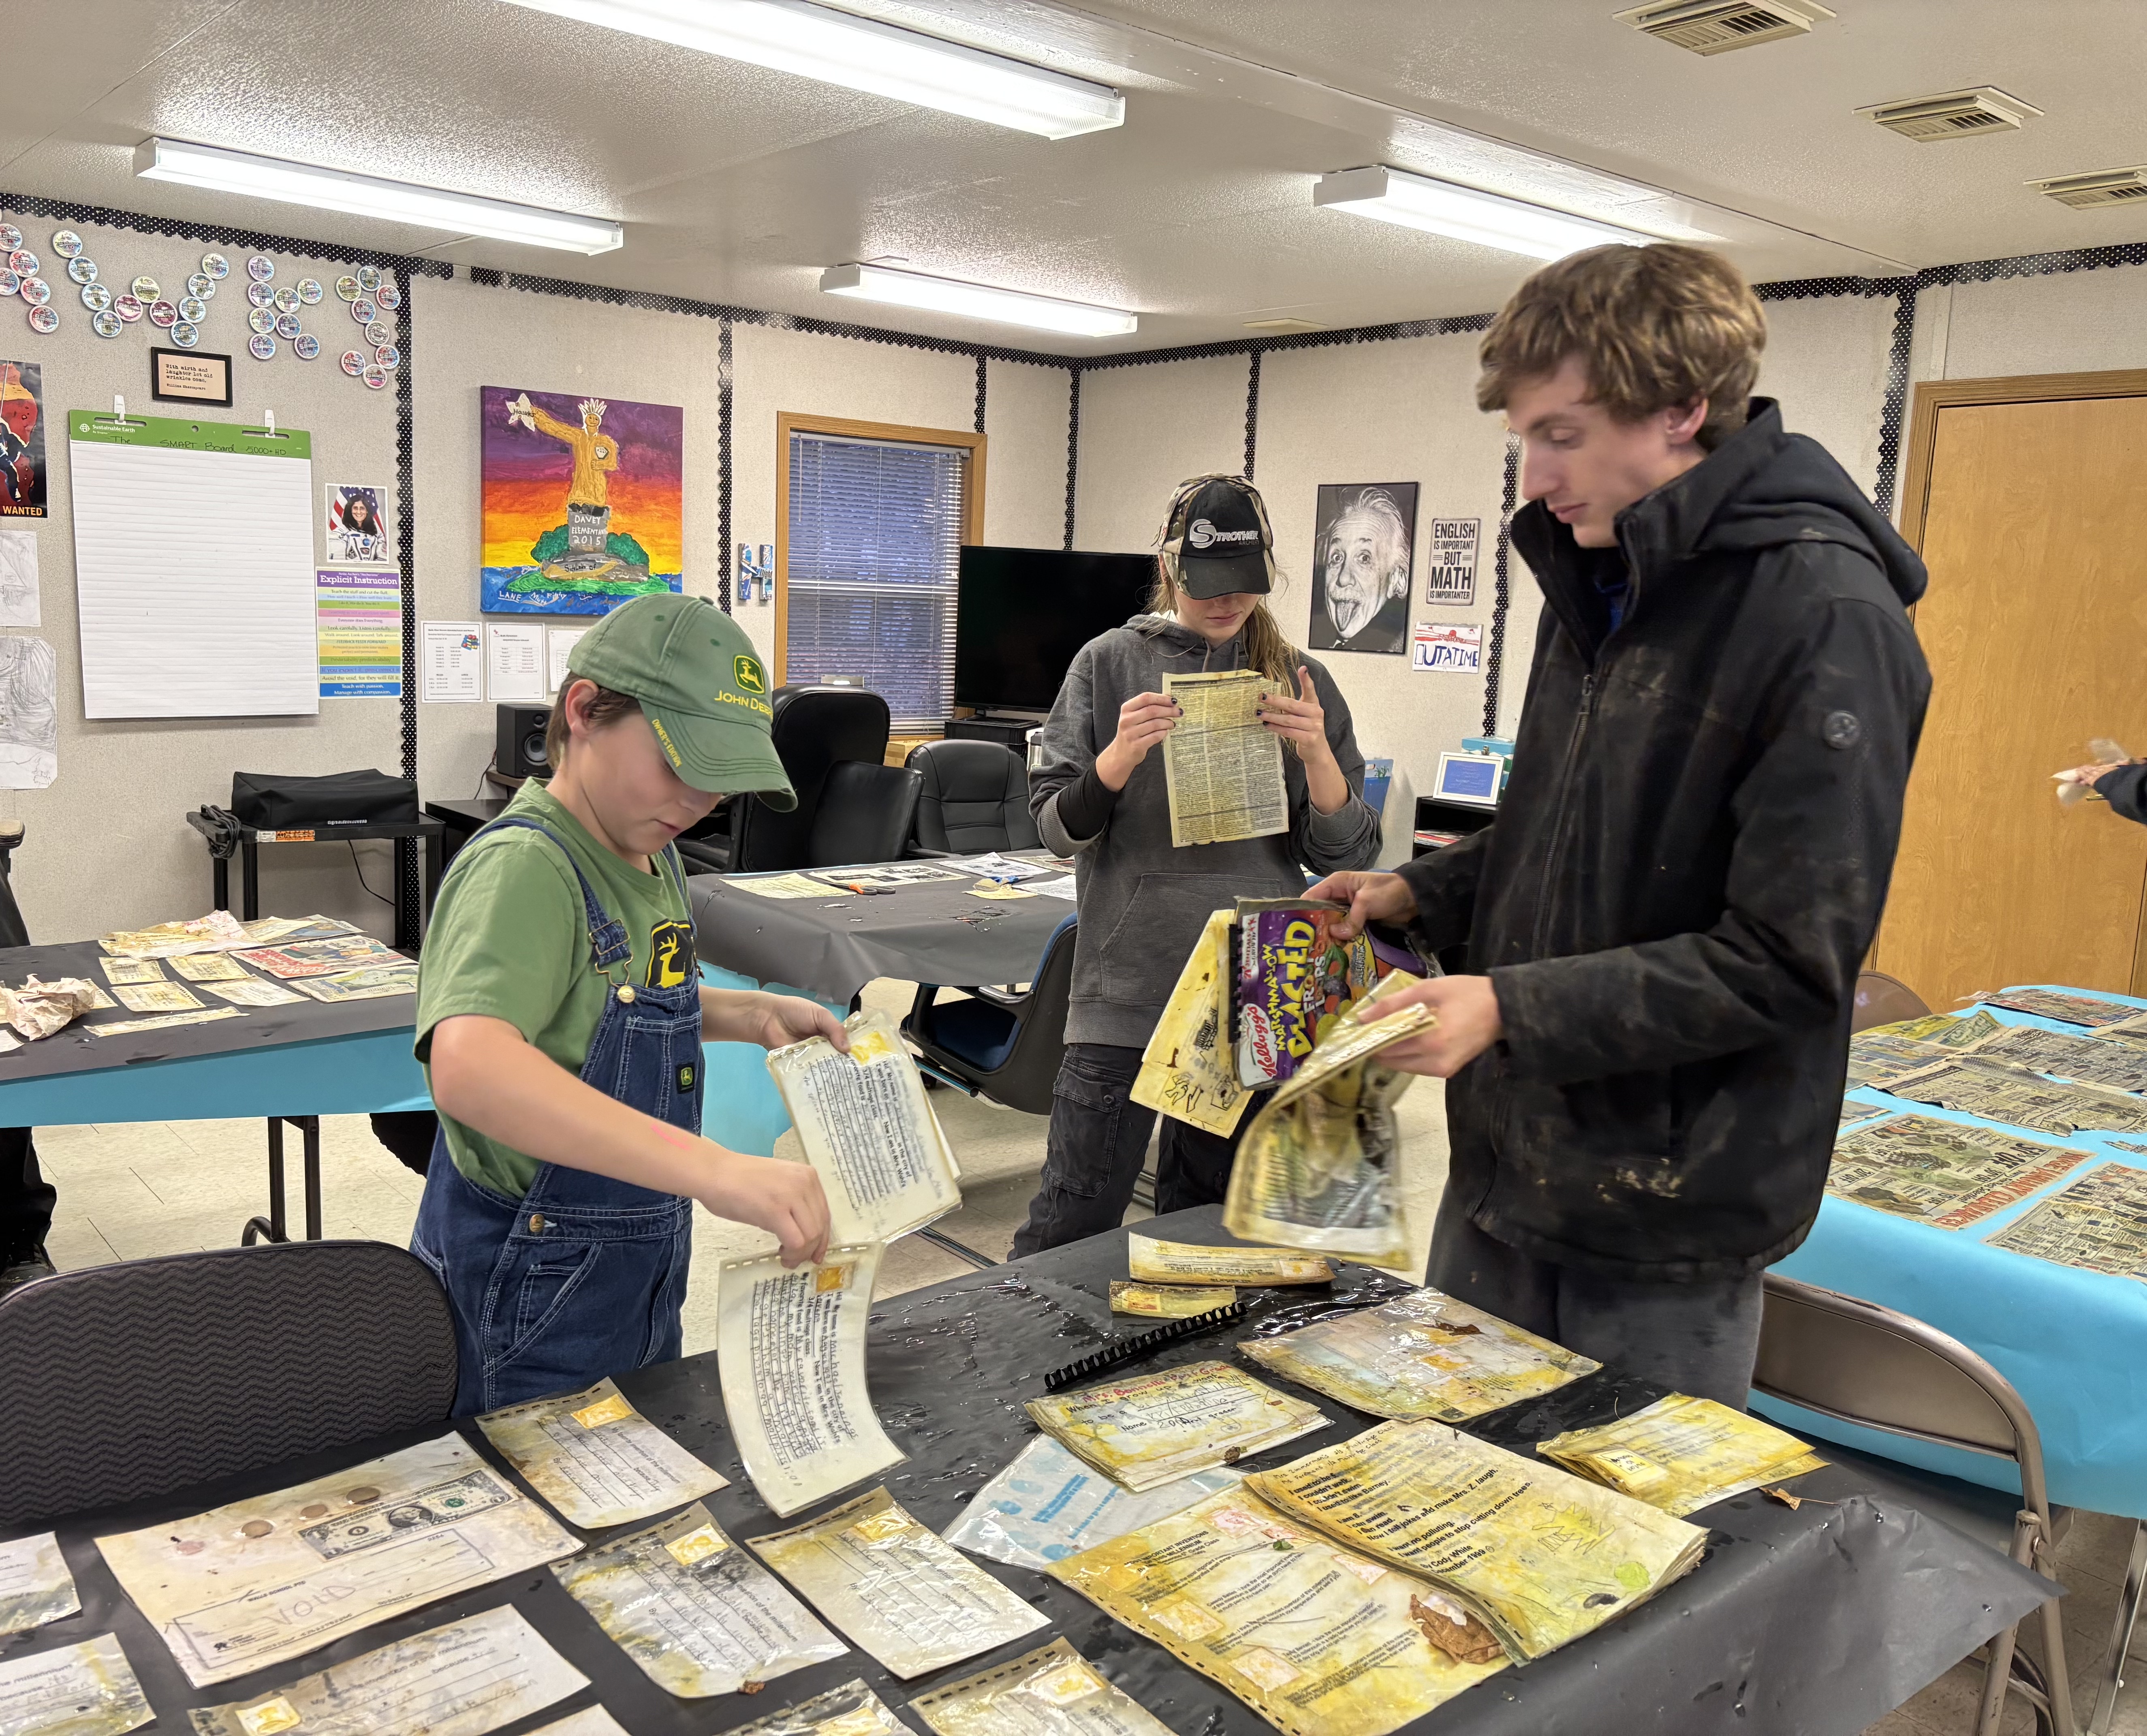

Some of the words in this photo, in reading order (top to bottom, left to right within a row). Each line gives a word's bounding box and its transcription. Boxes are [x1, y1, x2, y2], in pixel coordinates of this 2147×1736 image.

[512, 408, 536, 417] Hawks
[110, 436, 131, 444] The
[160, 440, 195, 449] SMART
[205, 443, 236, 453] Board
[2, 505, 42, 515] WANTED
[575, 515, 601, 524] DAVEY
[1435, 523, 1475, 539] ENGLISH
[573, 535, 601, 545] 2015
[1434, 541, 1440, 549] IS
[1441, 541, 1474, 550] IMPORTANT
[1444, 552, 1461, 565] BUT
[320, 575, 352, 584] Explicit
[354, 576, 397, 585] Instruction
[1431, 567, 1472, 589] MATH
[499, 591, 521, 601] LANE
[1430, 590, 1434, 599] IS
[1436, 591, 1470, 599] IMPORTANTER
[1415, 644, 1478, 667] OUTATIME
[714, 690, 749, 707] JOHN
[652, 719, 671, 746] OWNER'S
[666, 744, 682, 767] EDITION
[1262, 944, 1286, 1051] MARSHMALLOW
[1248, 1004, 1278, 1078] Kellogg's
[866, 1080, 875, 1104] multiage
[1066, 1403, 1097, 1413] When
[1121, 1390, 1148, 1401] grow
[1156, 1384, 1172, 1392] up
[1193, 1374, 1219, 1383] want
[1083, 1392, 1113, 1402] Mrs.
[820, 1402, 829, 1419] Mrs.
[1121, 1422, 1147, 1432] Name
[1366, 1434, 1378, 1443] Age
[1378, 1426, 1395, 1435] Class
[1365, 1439, 1382, 1450] Class
[1322, 1474, 1331, 1482] be
[1342, 1482, 1363, 1494] swim.
[1349, 1490, 1364, 1502] like
[1364, 1479, 1390, 1497] Barney.
[1368, 1532, 1385, 1541] Now
[1389, 1523, 1401, 1533] tell
[1401, 1514, 1421, 1529] jokes
[1421, 1506, 1435, 1517] and
[1434, 1497, 1454, 1510] make
[1453, 1490, 1470, 1500] Mrs.
[1475, 1469, 1498, 1486] laugh.
[1365, 1510, 1388, 1524] swim.
[1377, 1518, 1396, 1529] read.
[1403, 1547, 1422, 1557] want
[1421, 1536, 1446, 1552] people
[1445, 1531, 1455, 1540] to
[1454, 1523, 1471, 1535] stop
[1470, 1508, 1497, 1525] cutting
[1494, 1496, 1515, 1510] down
[1512, 1481, 1533, 1497] trees.
[1174, 1530, 1209, 1547] INVENTIONS
[1393, 1541, 1412, 1551] want
[1411, 1537, 1422, 1546] no
[1422, 1520, 1455, 1541] polluting.
[1167, 1539, 1202, 1556] MILLENNIUM
[1188, 1544, 1206, 1554] Grade
[1204, 1539, 1220, 1548] Class
[1420, 1561, 1433, 1569] By
[1430, 1554, 1451, 1568] Cody
[1450, 1544, 1474, 1559] White
[1431, 1559, 1468, 1574] December
[1467, 1549, 1486, 1561] 1999
[262, 1585, 357, 1625] VOID
[942, 1593, 965, 1609] because
[968, 1588, 1000, 1615] millennium
[742, 1615, 763, 1634] because
[769, 1615, 798, 1642] millennium
[438, 1636, 487, 1655] millennium
[432, 1656, 470, 1674] because
